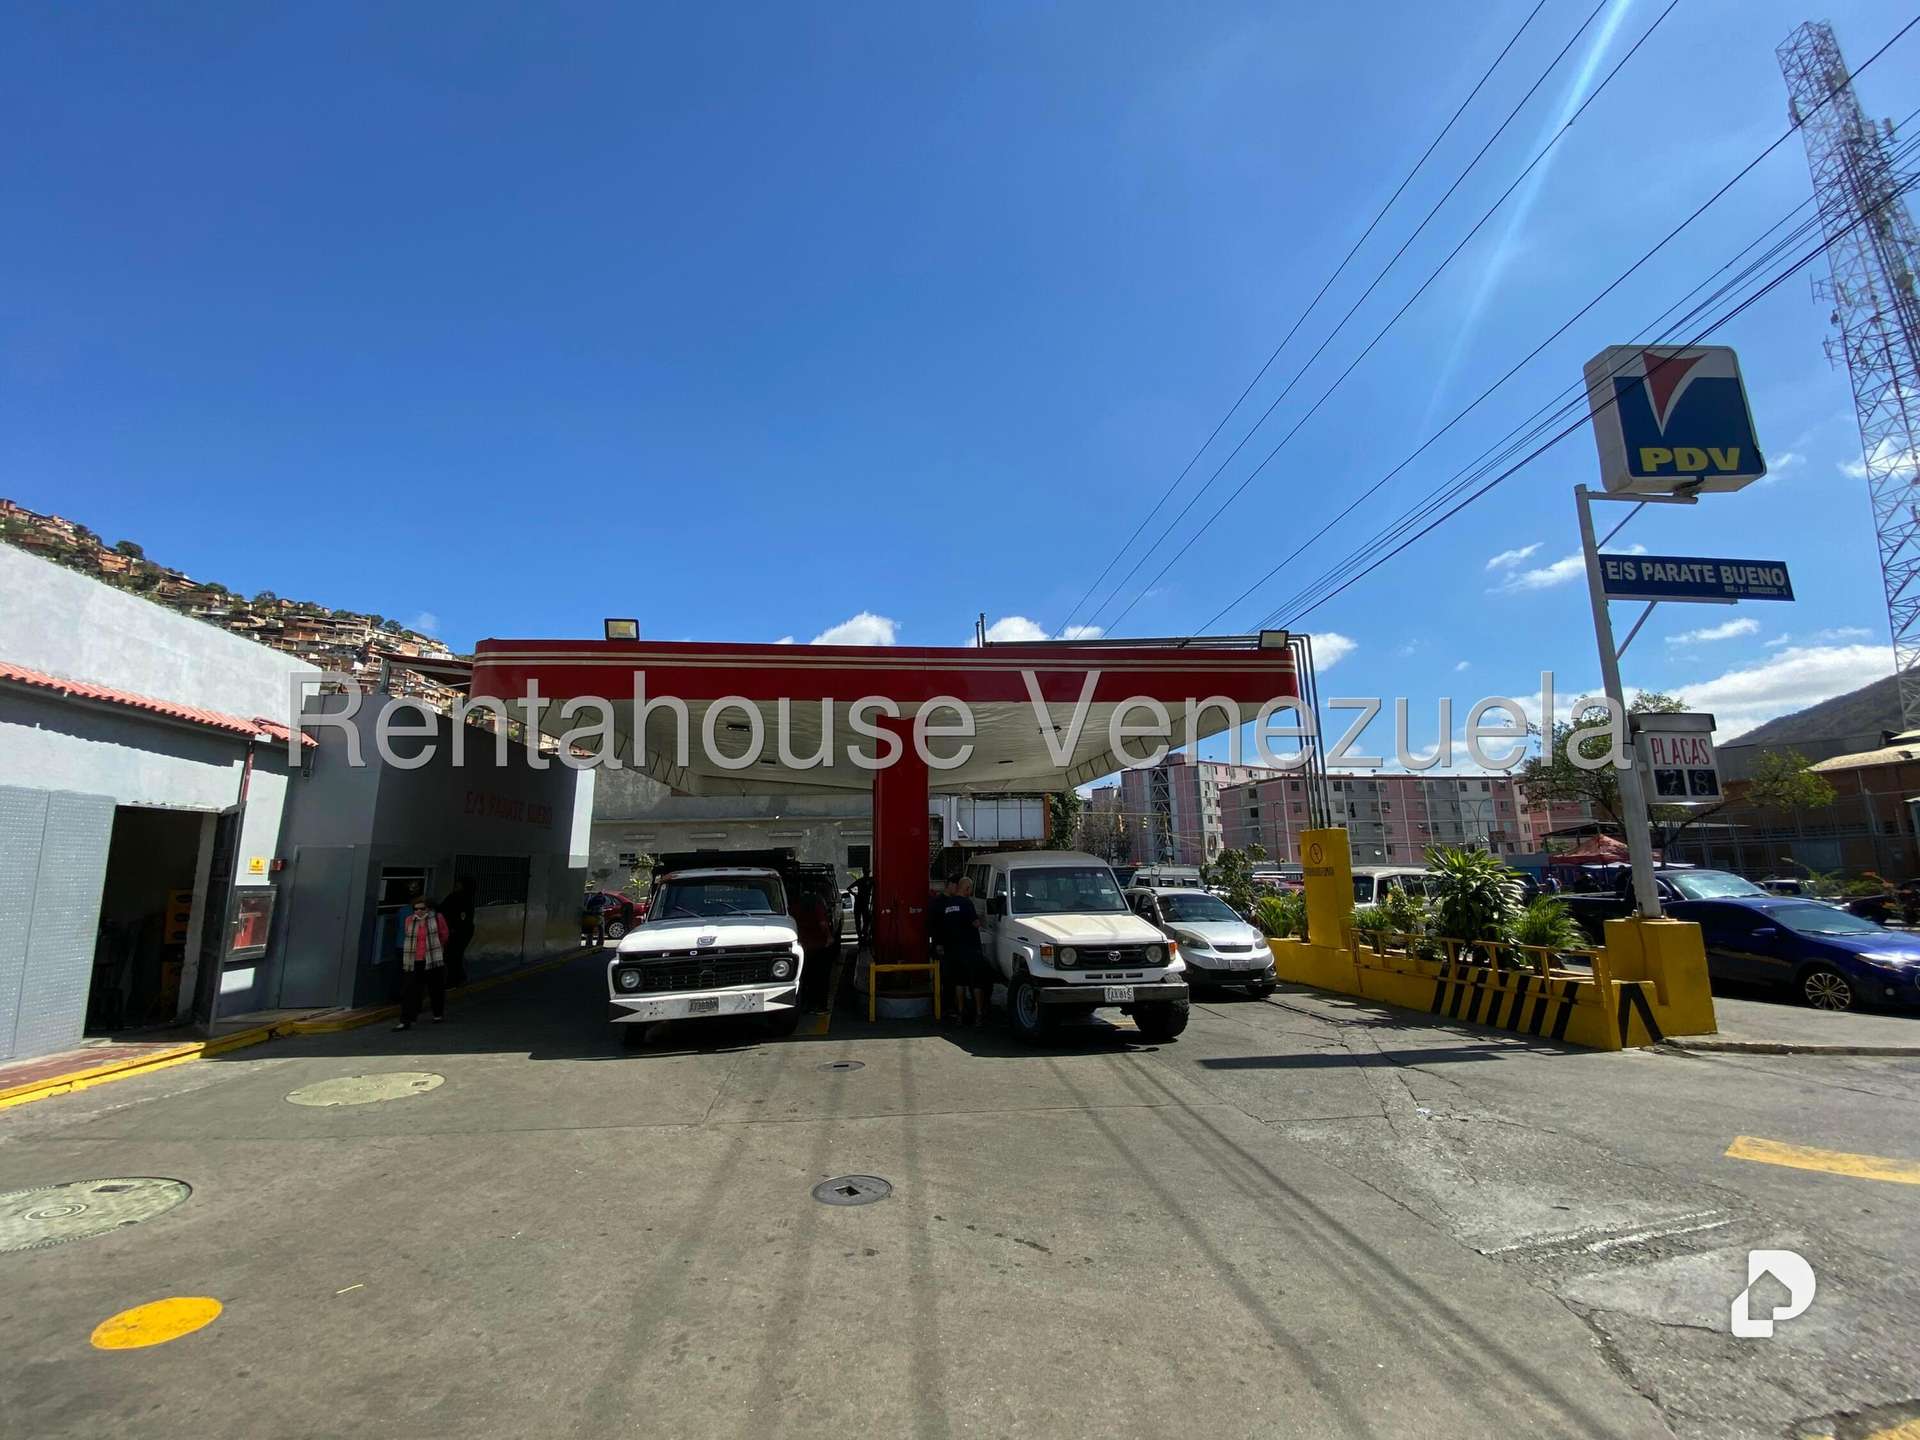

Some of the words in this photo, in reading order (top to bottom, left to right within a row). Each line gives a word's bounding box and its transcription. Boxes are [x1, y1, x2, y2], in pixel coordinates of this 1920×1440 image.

[1639, 447, 1740, 472] PDV
[1606, 561, 1636, 581] E/S
[1641, 563, 1716, 584] PARATE
[1719, 566, 1786, 586] BUENO
[1650, 737, 1710, 765] PLACAS
